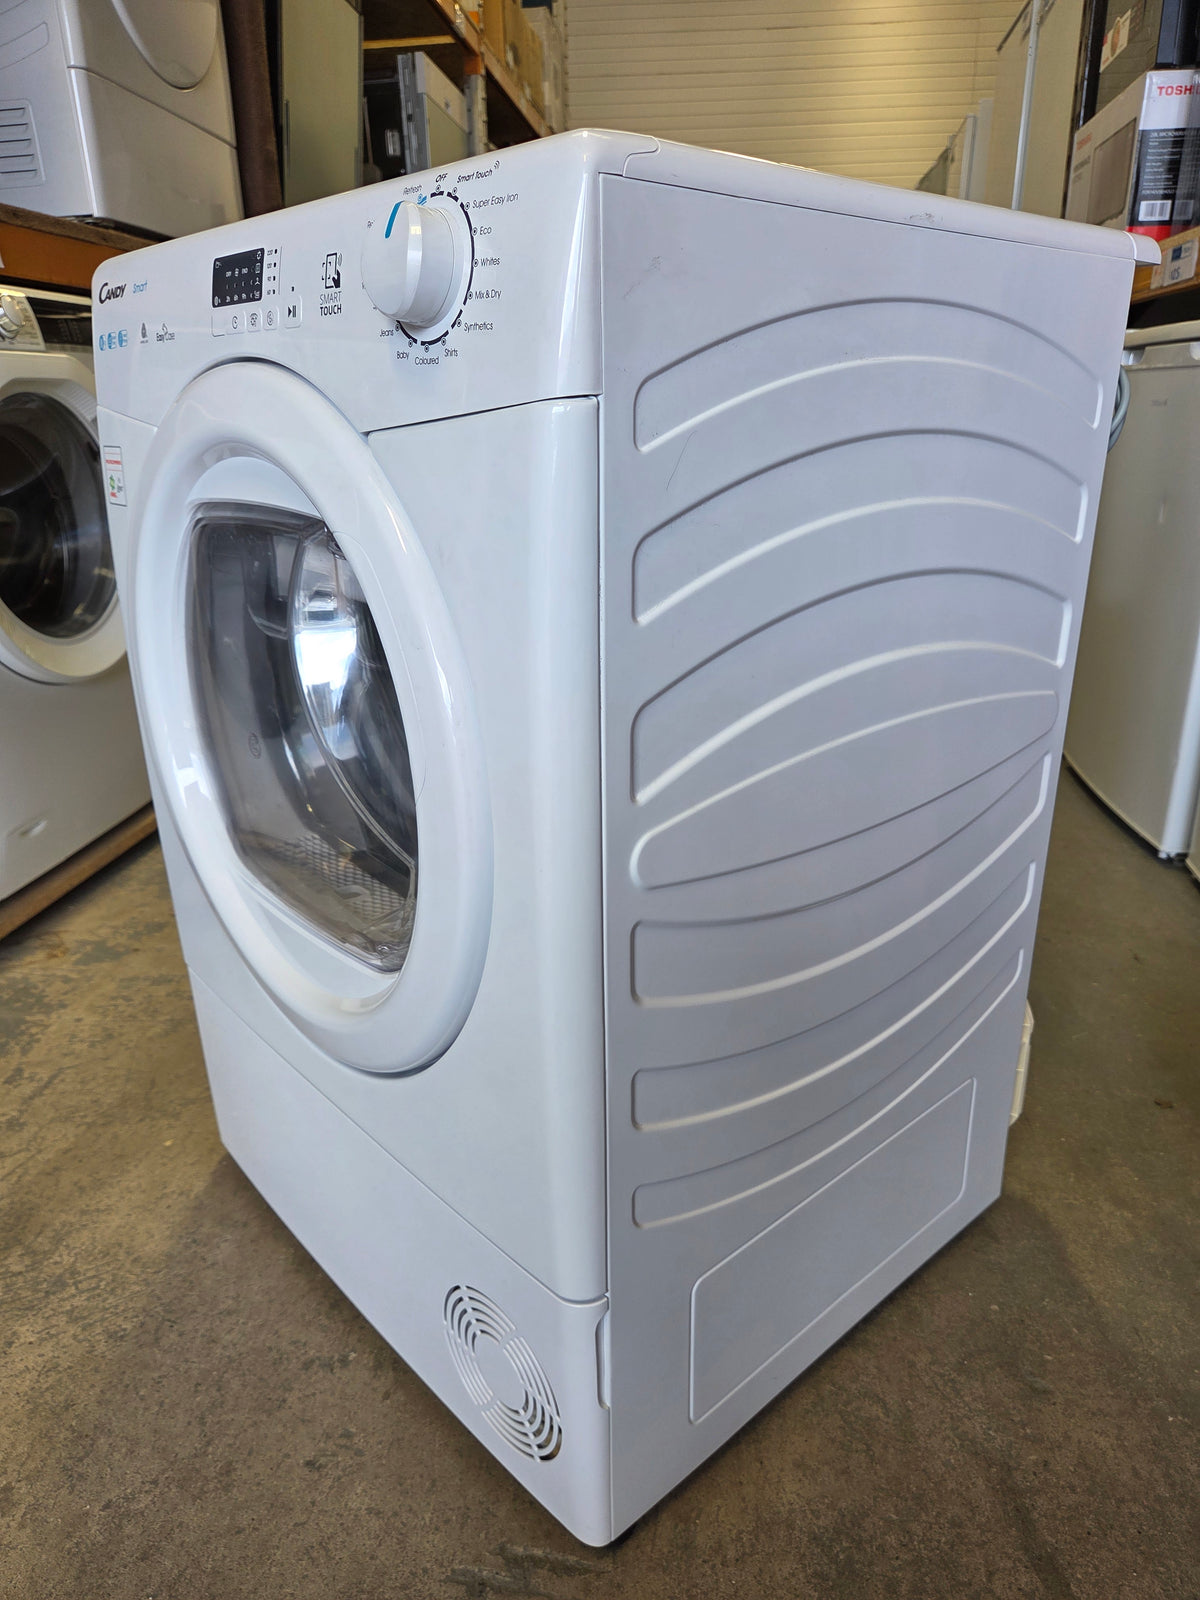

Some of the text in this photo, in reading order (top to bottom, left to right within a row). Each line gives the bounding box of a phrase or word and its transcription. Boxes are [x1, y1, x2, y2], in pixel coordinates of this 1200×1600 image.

[435, 173, 448, 183] OFF
[456, 169, 493, 184] Smart Touch
[472, 192, 519, 210] Super Easy Iron
[479, 226, 492, 236] Eco
[480, 257, 500, 267] Whites
[99, 280, 148, 304] CANDY Smart
[474, 291, 485, 300] Mix
[490, 289, 502, 300] Dry
[319, 291, 342, 306] SMART
[319, 304, 342, 316] TOUCH
[379, 328, 394, 337] Jeans
[463, 321, 494, 333] Synthetics
[396, 350, 410, 361] Baby
[444, 348, 459, 358] Shirts
[414, 355, 440, 366] Coloured
